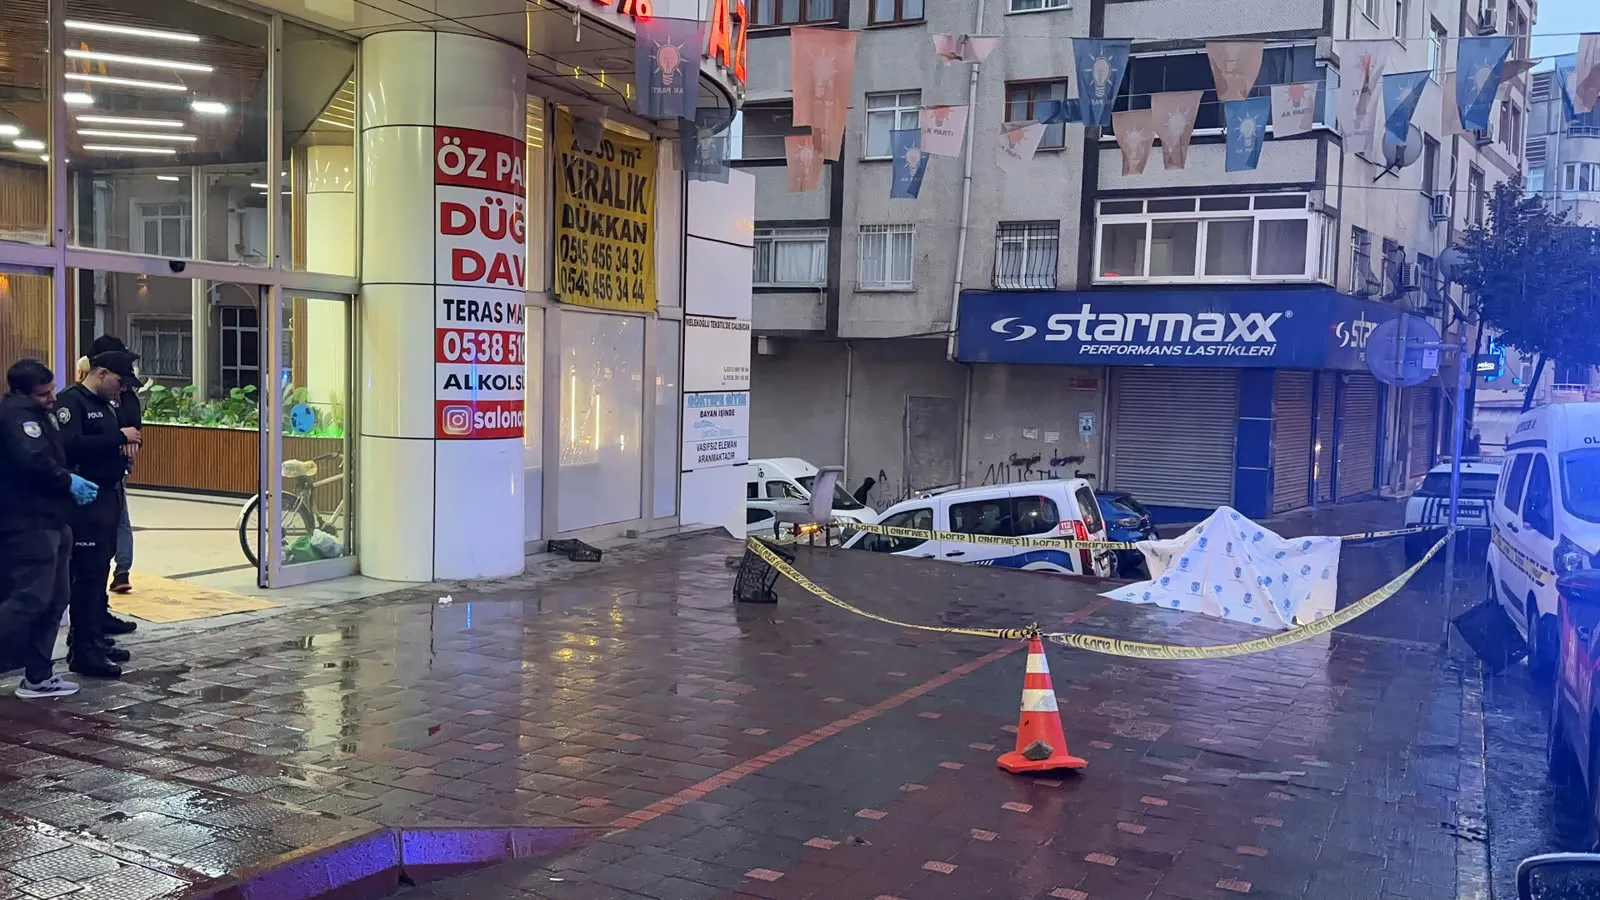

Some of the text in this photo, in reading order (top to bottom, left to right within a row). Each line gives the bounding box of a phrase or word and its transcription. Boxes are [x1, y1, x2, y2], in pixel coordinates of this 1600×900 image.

[437, 136, 526, 188] ÖZ PA
[440, 196, 525, 244] DÜĞ
[562, 203, 647, 244] DÜKKAN
[592, 242, 612, 271] 456
[616, 246, 629, 273] 34
[560, 267, 589, 297] 0545
[592, 272, 613, 300] 456
[616, 276, 629, 303] 34
[443, 299, 503, 323] TERAS
[1045, 304, 1281, 342] starmaxx
[443, 331, 503, 362] 0538
[1079, 342, 1276, 357] PERFORMANS LASTİKLERİ
[474, 405, 525, 429] salono
[700, 410, 717, 418] BAYAN
[718, 440, 738, 450] ELEMAN
